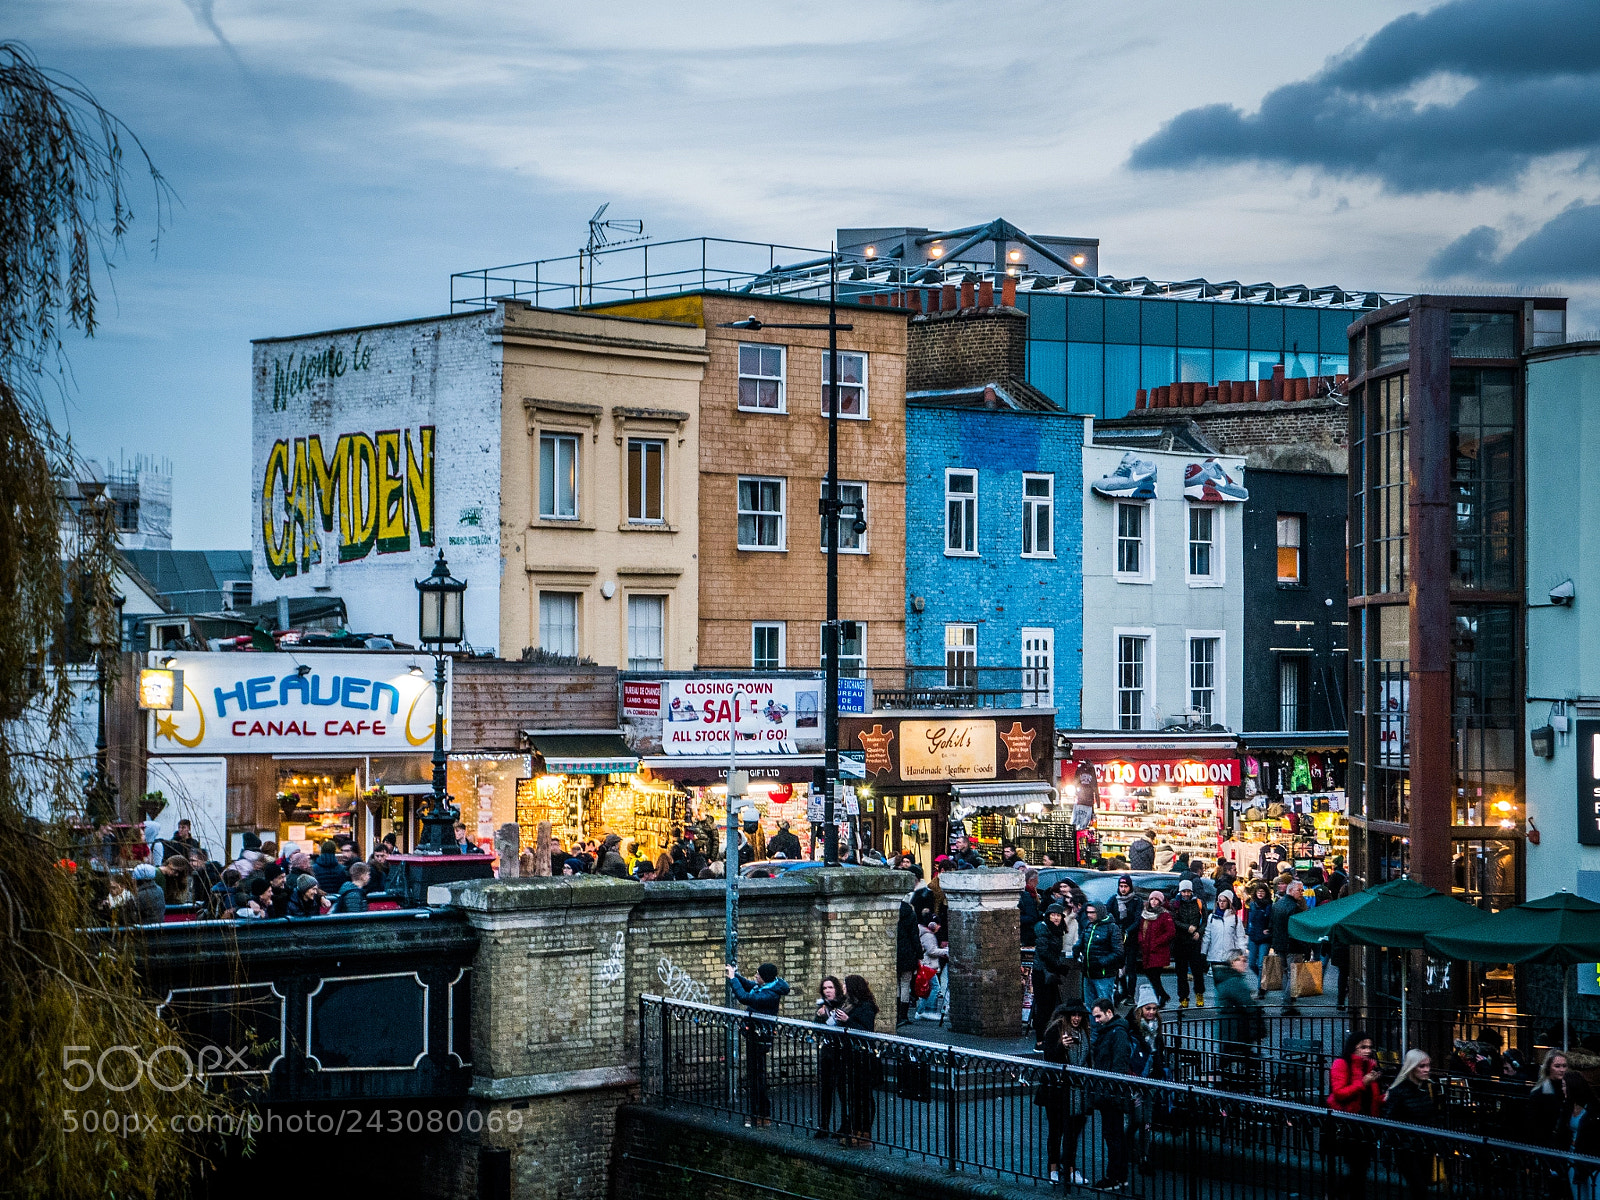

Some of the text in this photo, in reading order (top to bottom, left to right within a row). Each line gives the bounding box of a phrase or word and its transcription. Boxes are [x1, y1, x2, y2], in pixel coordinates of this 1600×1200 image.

[273, 333, 373, 412] Welcome to
[262, 425, 435, 580] CAMDEN
[685, 683, 734, 694] CLOSING
[231, 720, 387, 737] CANAL CAFE
[672, 729, 788, 742] ALL STOCK MT GO!
[925, 726, 973, 754] Gohil's
[749, 769, 765, 777] GIFT
[767, 769, 780, 777] LTD
[905, 763, 993, 777] Handmade Leather Goods
[1094, 763, 1136, 783] ETLO
[1138, 763, 1161, 783] OF
[1163, 763, 1232, 783] LONDON
